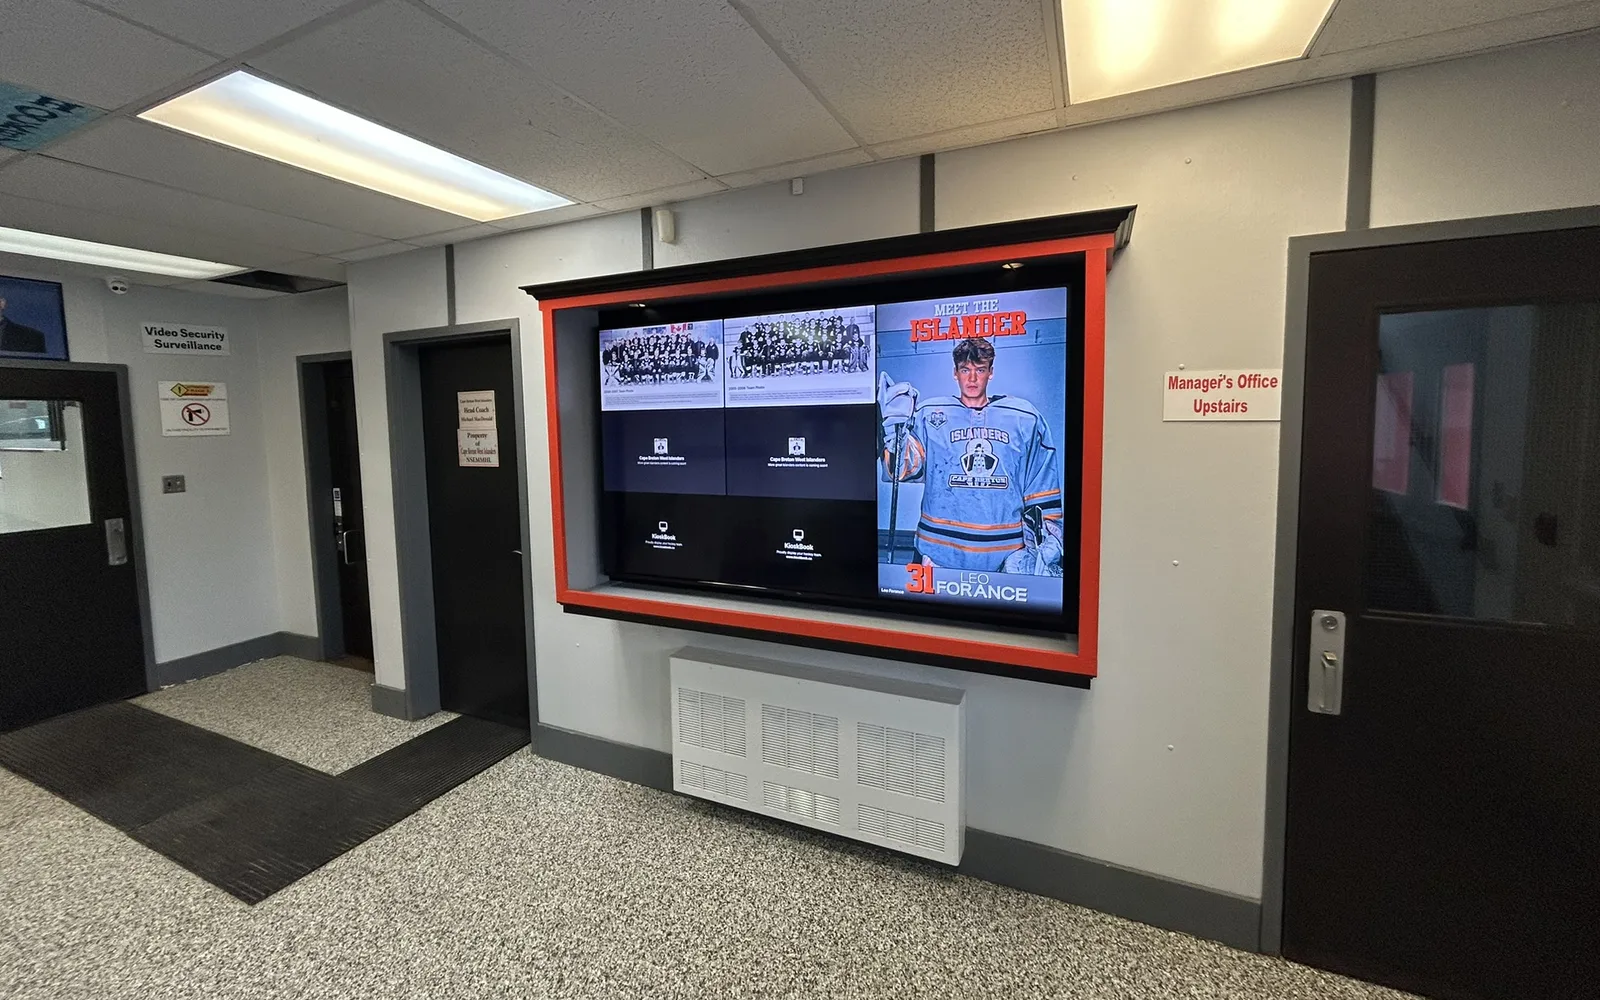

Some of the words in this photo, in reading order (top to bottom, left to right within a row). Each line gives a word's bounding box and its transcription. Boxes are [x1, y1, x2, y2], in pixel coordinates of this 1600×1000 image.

[934, 302, 969, 317] MEET
[973, 299, 999, 313] THE
[144, 326, 178, 337] Video
[180, 328, 225, 341] Security
[910, 310, 1026, 342] ISLANDER
[154, 339, 222, 351] Surveillance
[1168, 374, 1233, 393] Manager's
[1237, 374, 1279, 389] Office
[1193, 398, 1248, 416] Upstairs
[466, 432, 488, 440] Property
[950, 427, 1010, 444] ISLANDERS
[784, 542, 814, 551] KioskBook
[906, 563, 936, 595] 31
[960, 572, 990, 585] LEO
[936, 581, 1028, 602] FORANCE
